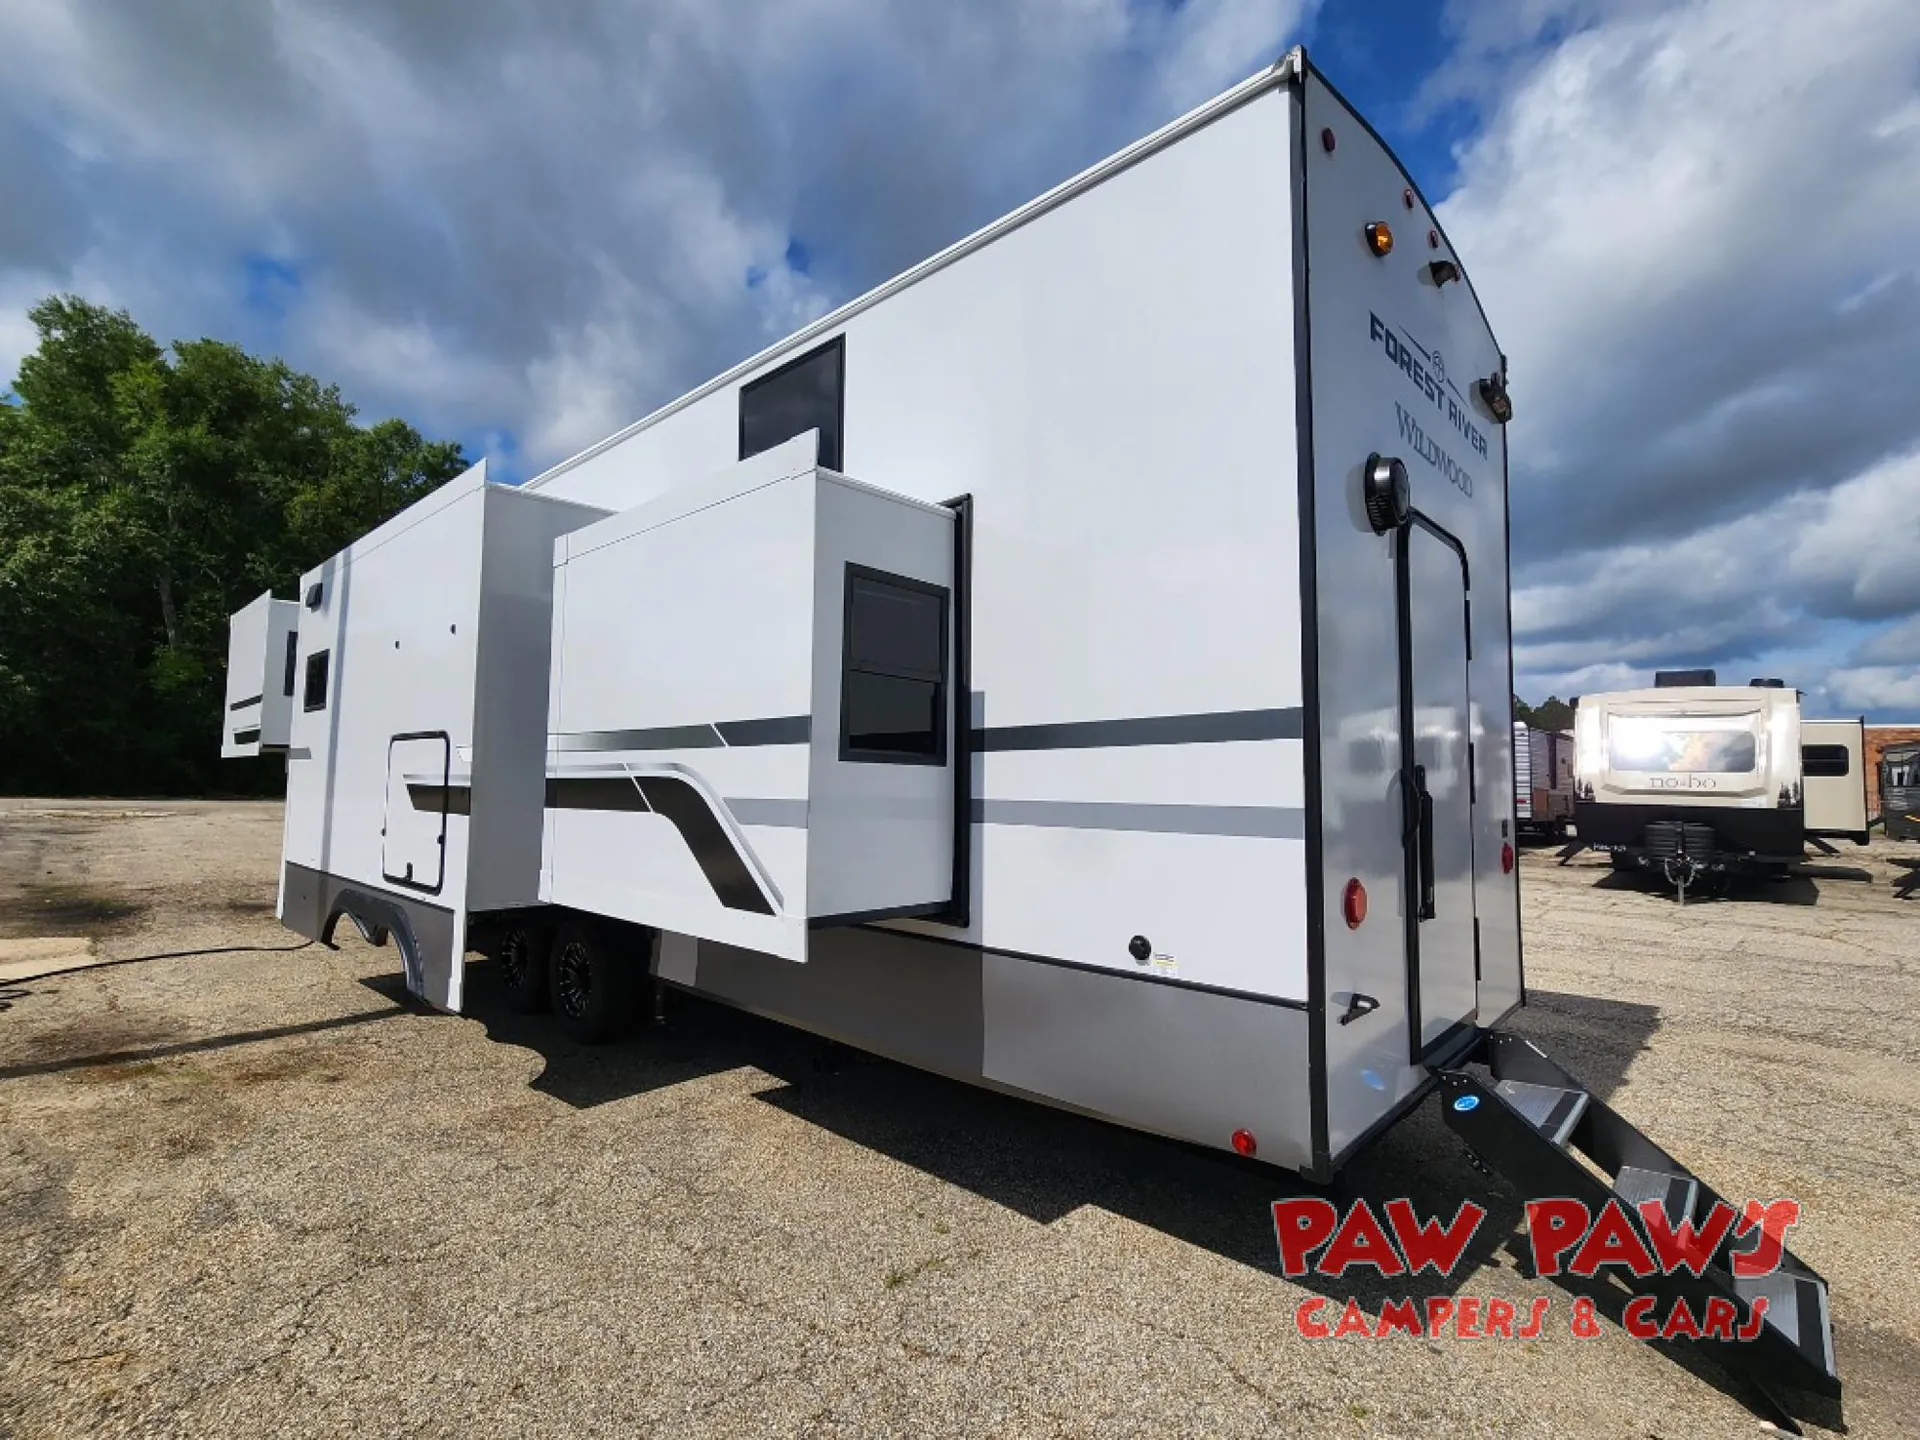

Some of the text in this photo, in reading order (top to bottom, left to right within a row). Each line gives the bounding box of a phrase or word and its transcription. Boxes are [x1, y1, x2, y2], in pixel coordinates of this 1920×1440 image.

[1369, 309, 1488, 461] FOREST RIVER
[1395, 400, 1473, 499] WILDWOOD
